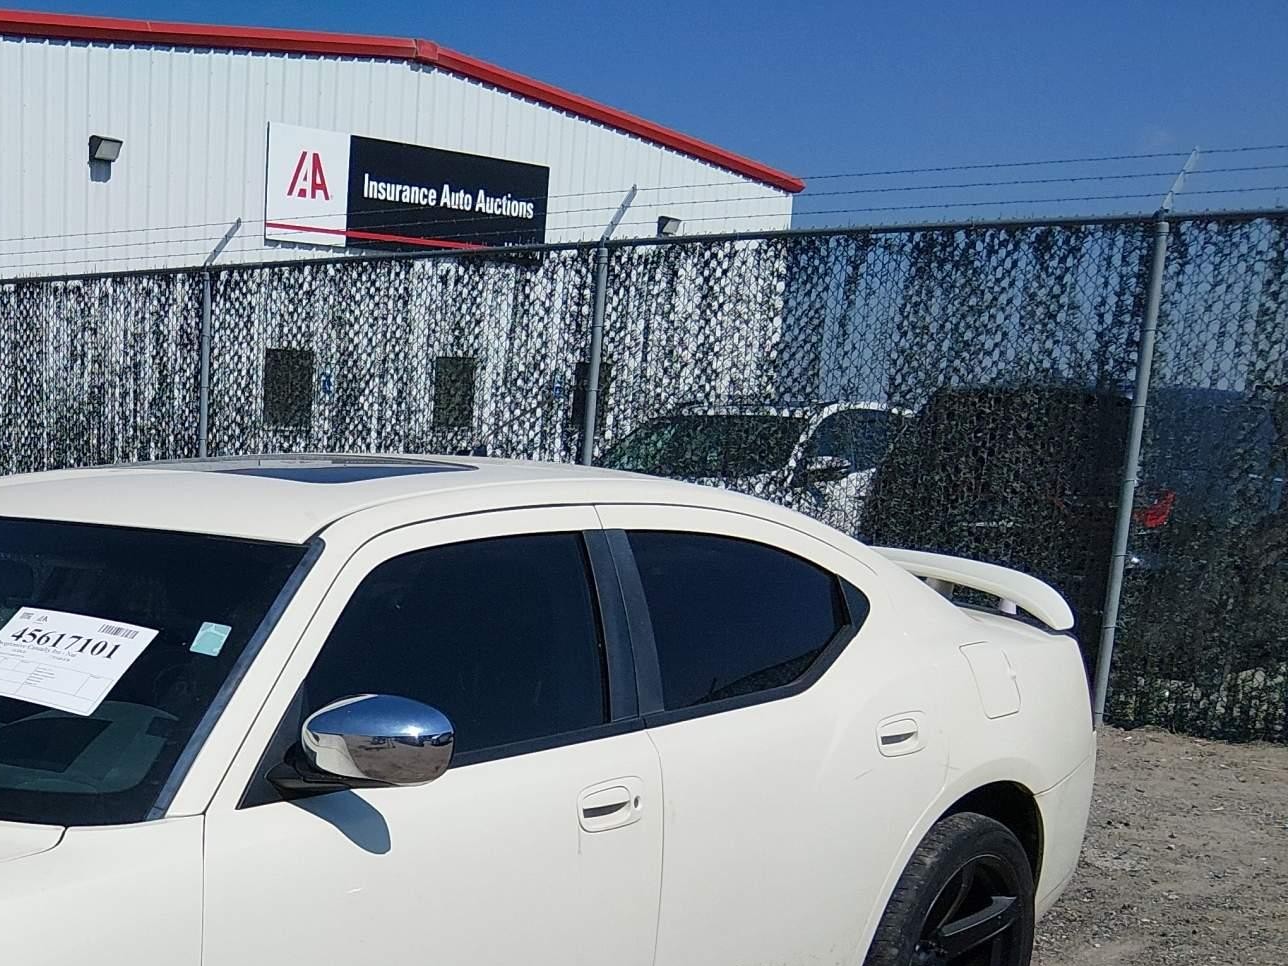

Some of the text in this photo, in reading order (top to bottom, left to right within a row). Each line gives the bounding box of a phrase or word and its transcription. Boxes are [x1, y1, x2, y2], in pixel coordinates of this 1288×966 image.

[363, 172, 534, 220] Insurance Auto Auctions
[10, 626, 121, 660] 45617101
